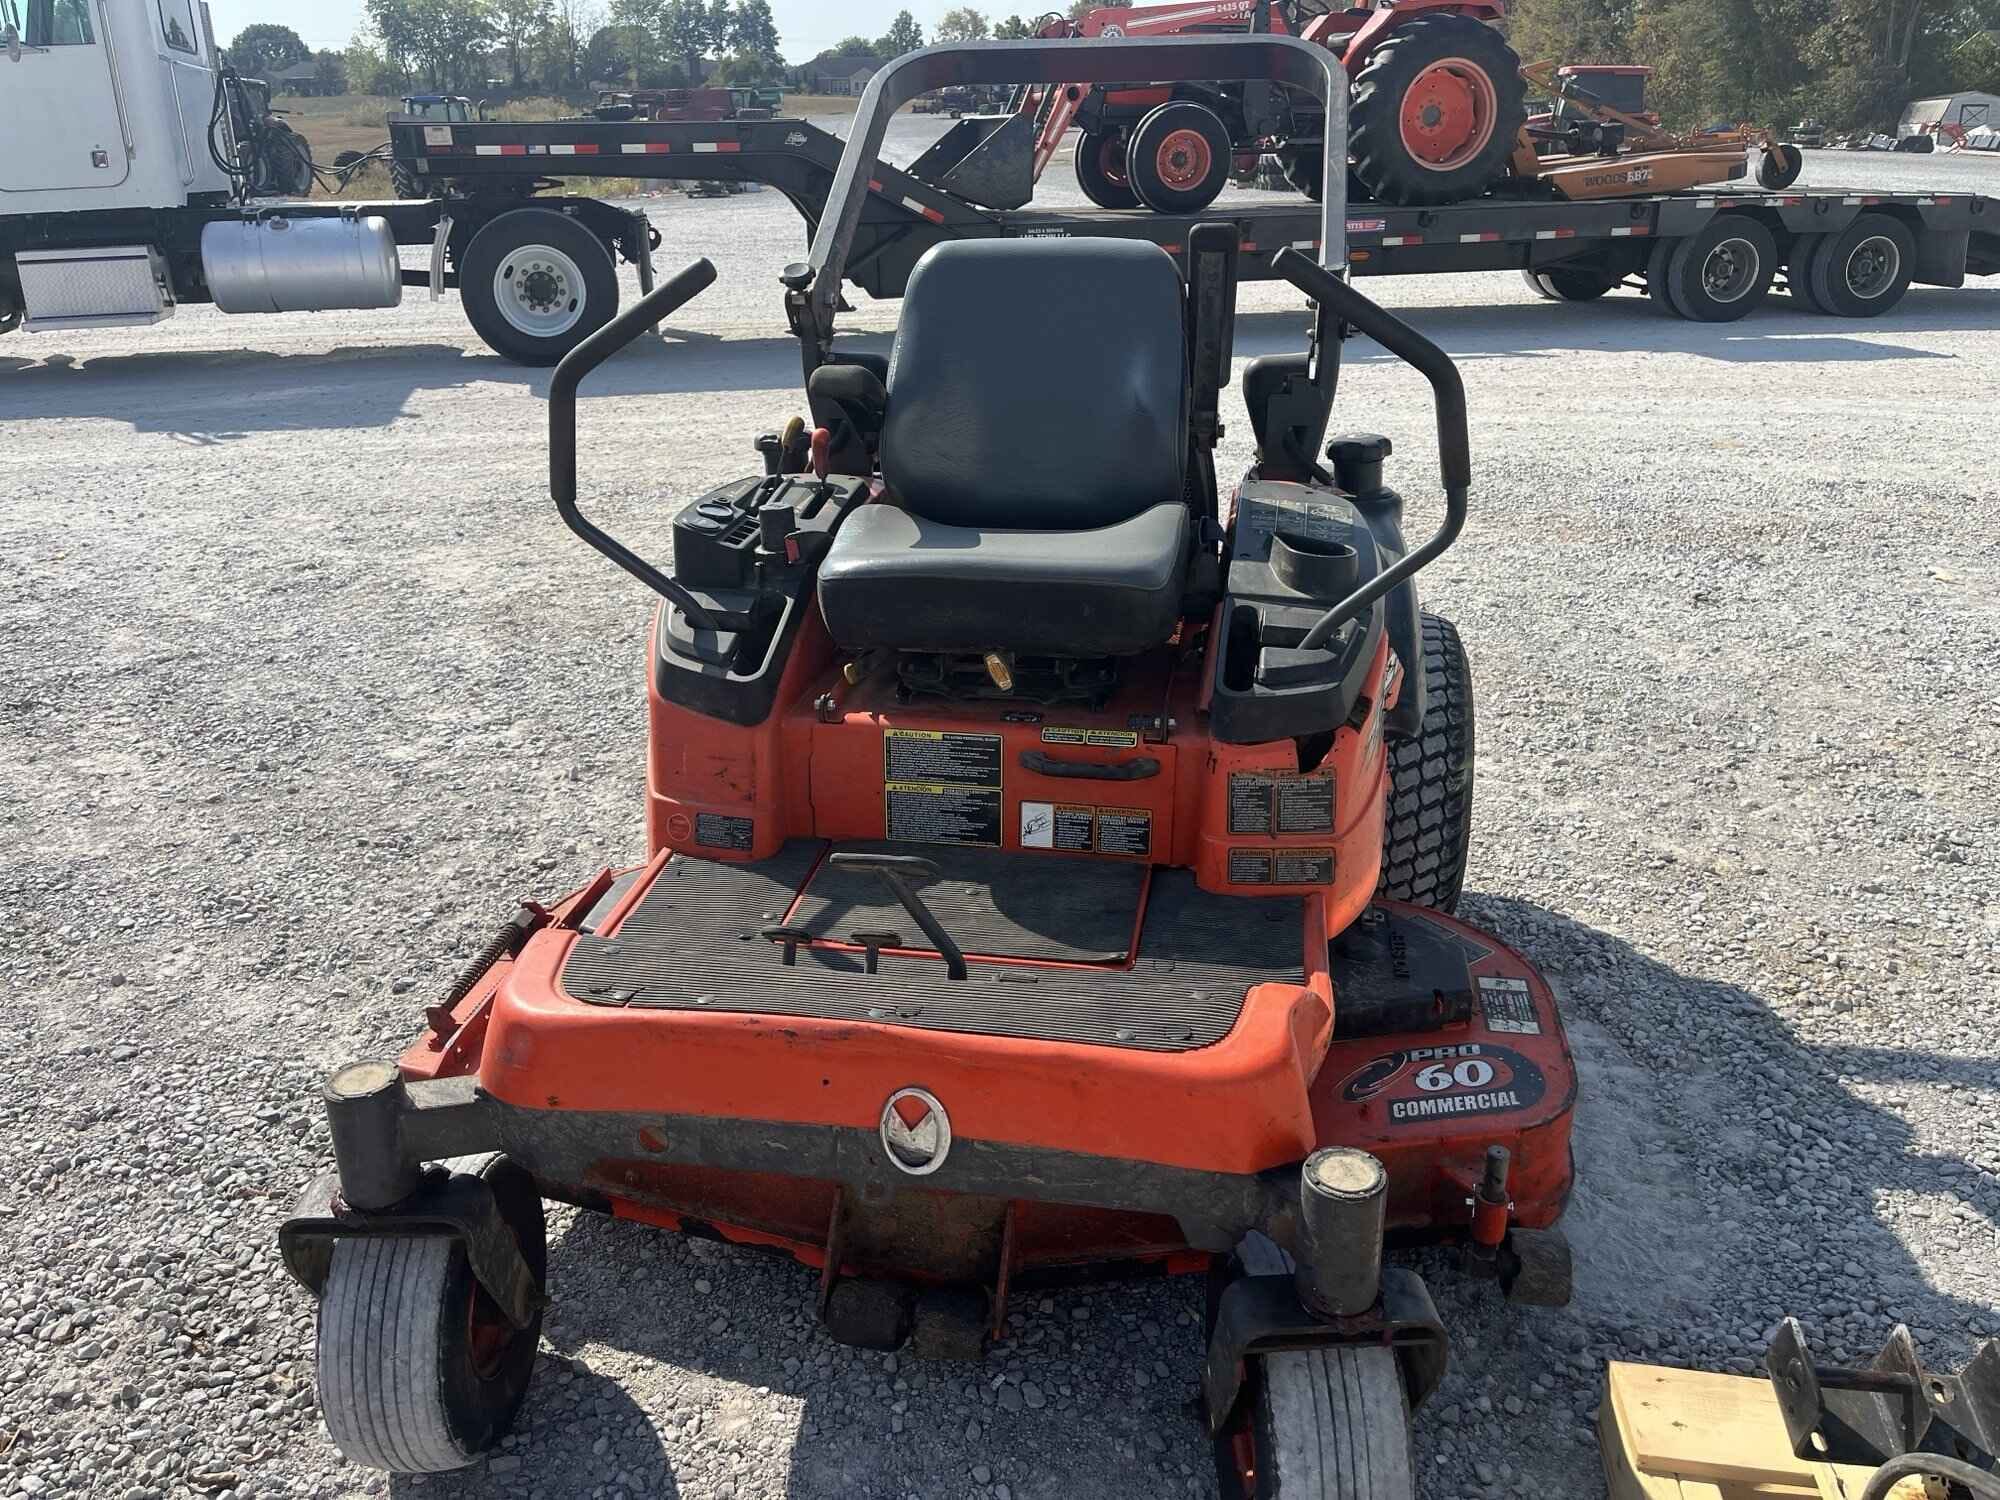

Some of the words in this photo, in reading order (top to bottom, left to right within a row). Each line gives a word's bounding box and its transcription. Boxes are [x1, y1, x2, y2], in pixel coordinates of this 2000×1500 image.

[1411, 1044, 1481, 1062] PRO
[1415, 1060, 1494, 1091] 60
[1393, 1091, 1520, 1118] COMMERCIAL
